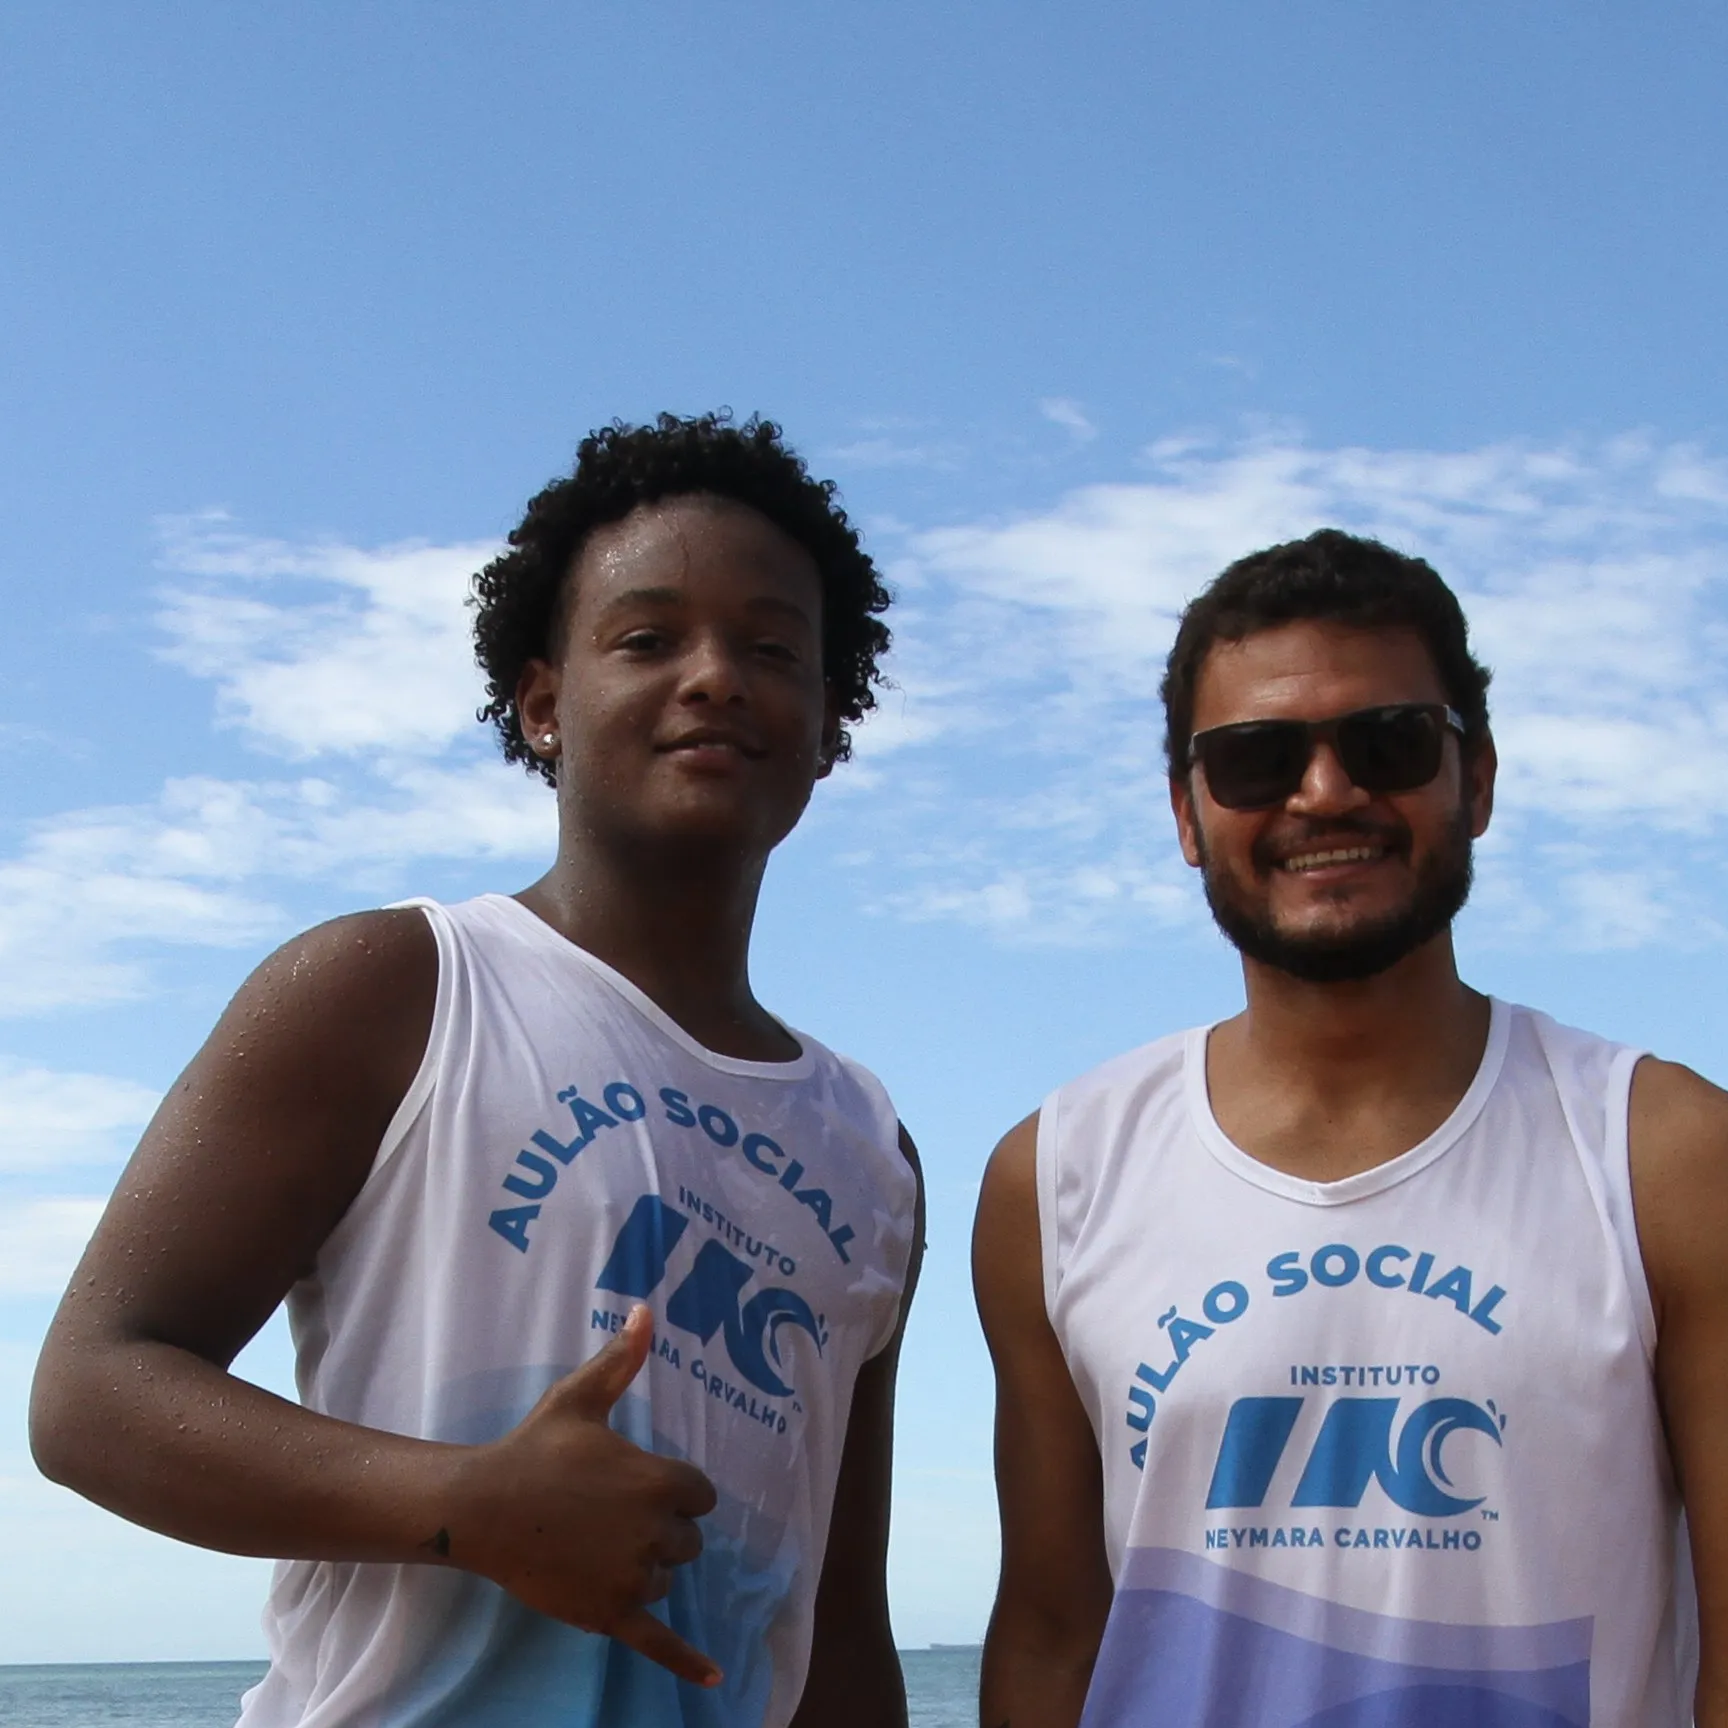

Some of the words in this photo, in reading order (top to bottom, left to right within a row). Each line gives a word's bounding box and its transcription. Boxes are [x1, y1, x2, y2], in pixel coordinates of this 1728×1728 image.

[488, 1082, 646, 1254] AULÃO
[658, 1086, 858, 1265] SOCIAL
[679, 1185, 797, 1277] INSTITUTO
[1265, 1243, 1508, 1336] SOCIAL
[1290, 1364, 1441, 1387] INSTITUTO
[1205, 1528, 1325, 1550] NEYMARA
[1334, 1527, 1482, 1552] CARVALHO
